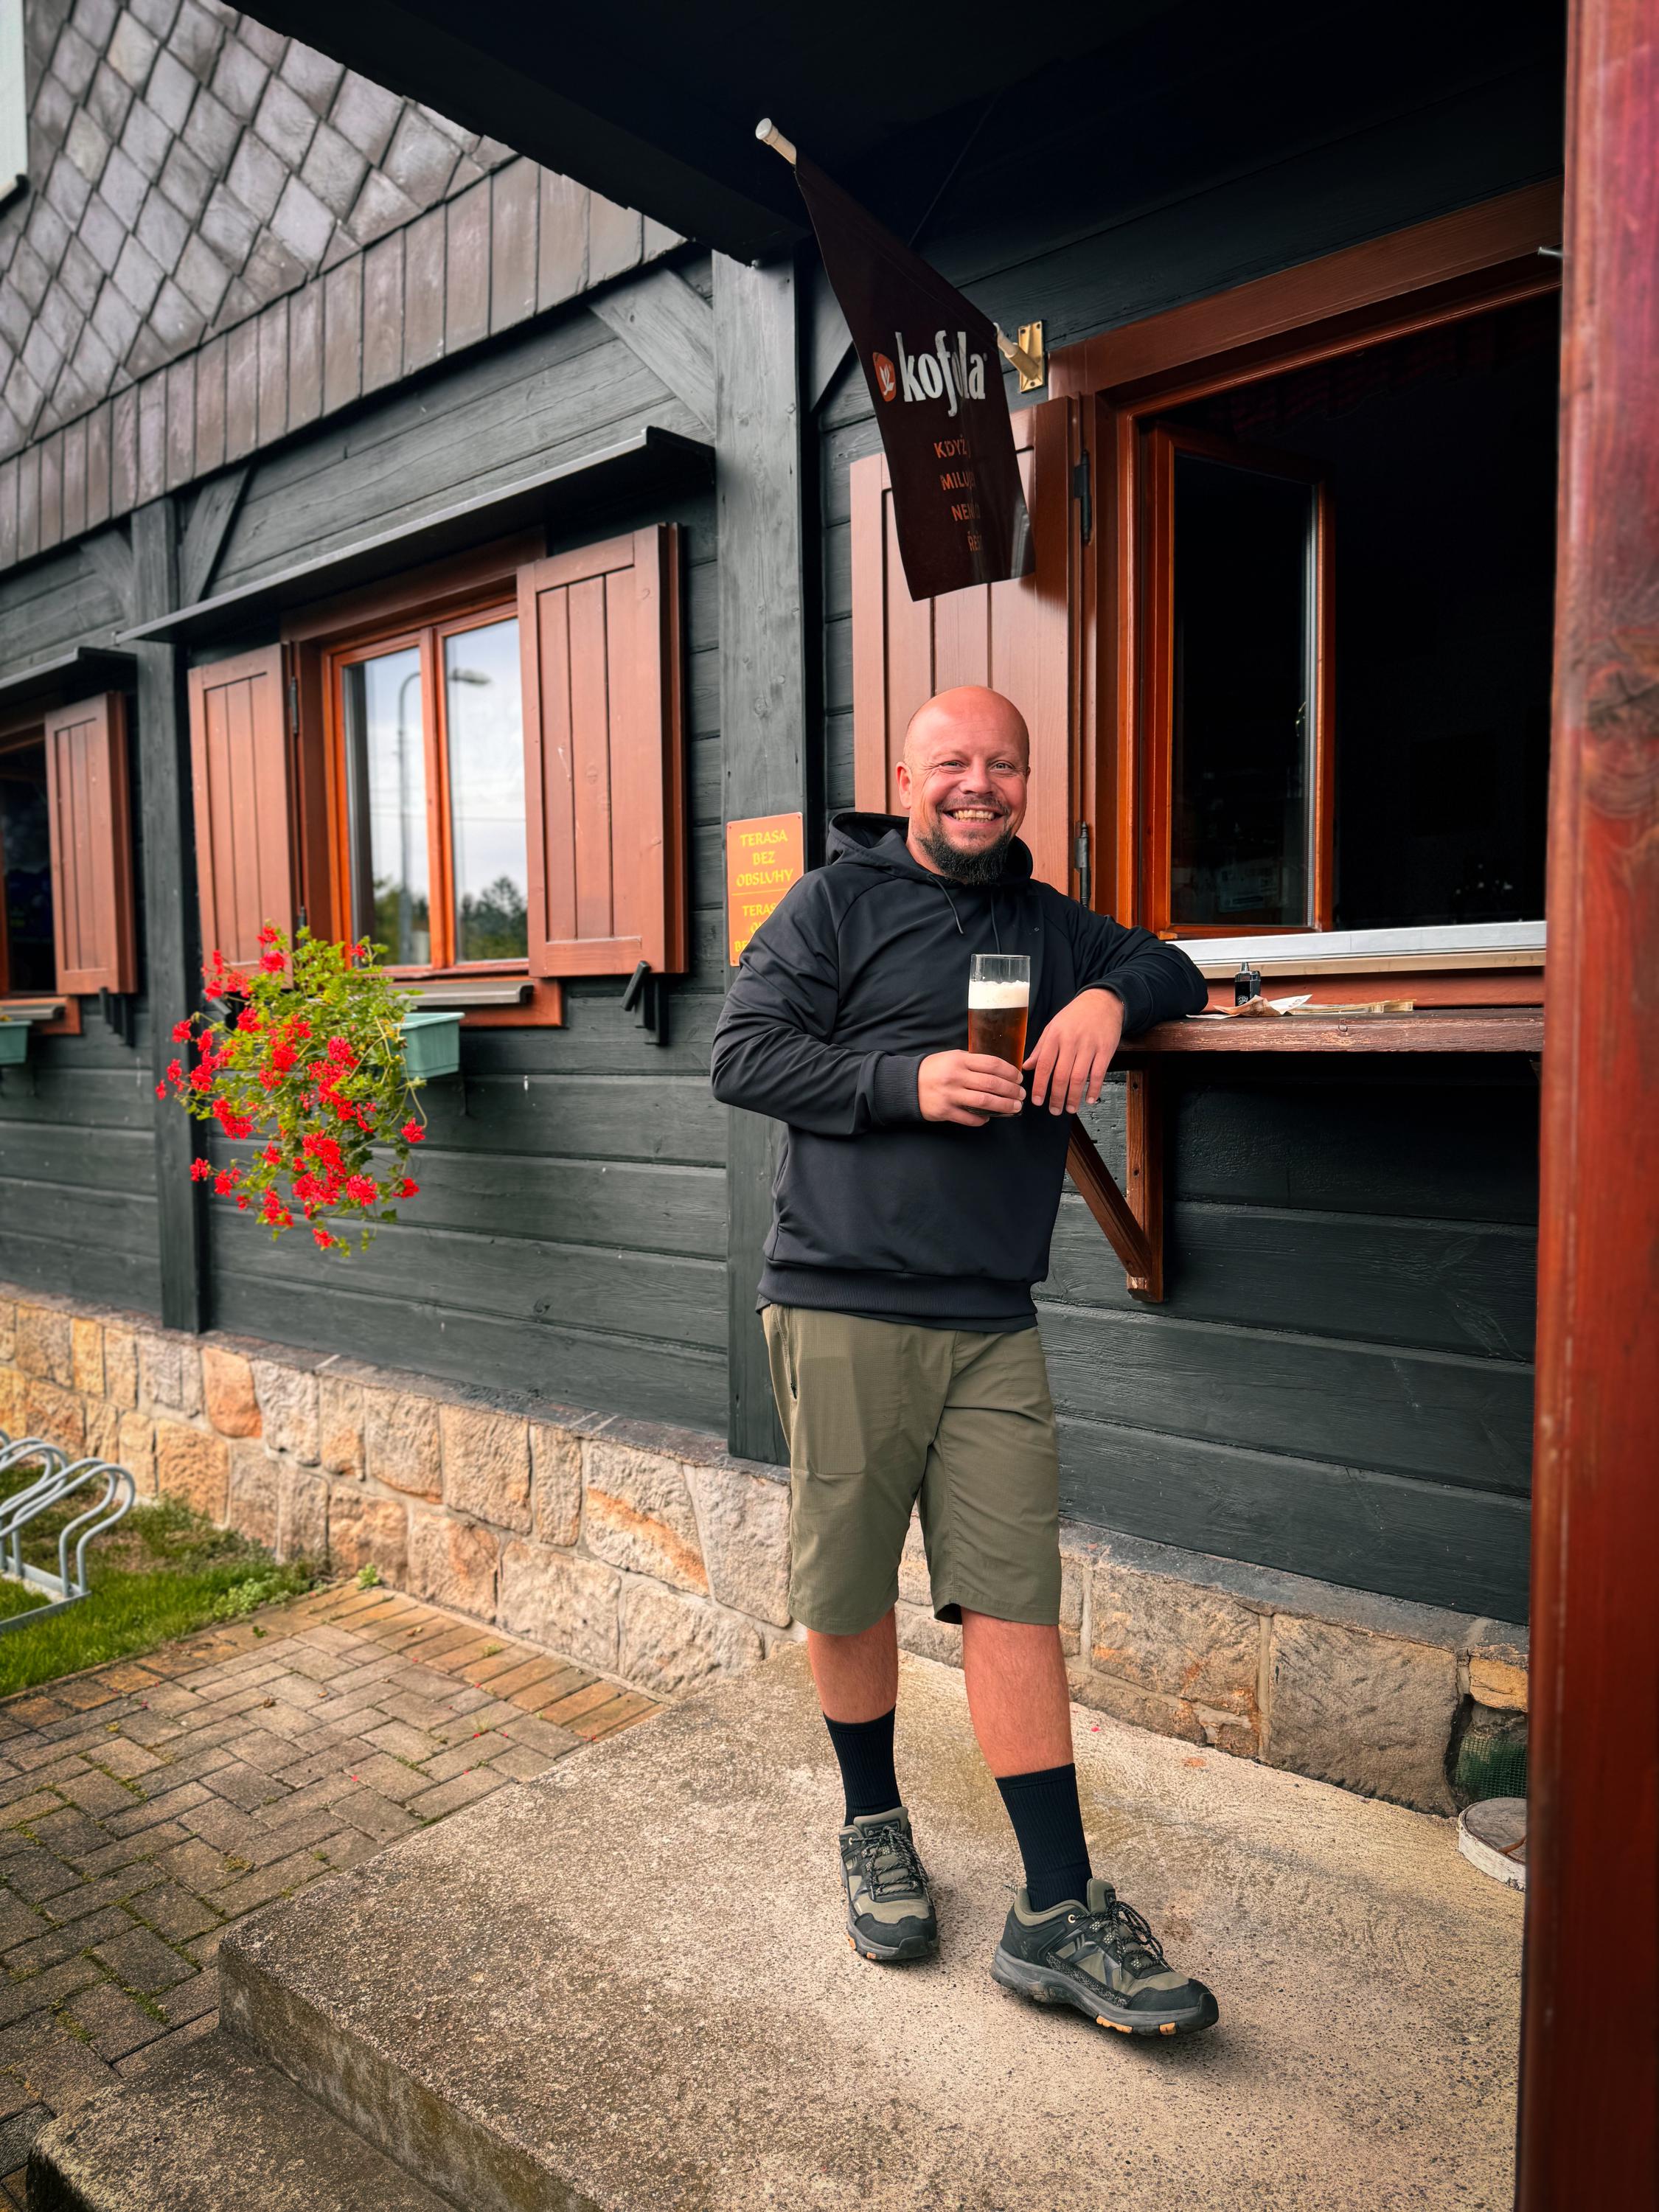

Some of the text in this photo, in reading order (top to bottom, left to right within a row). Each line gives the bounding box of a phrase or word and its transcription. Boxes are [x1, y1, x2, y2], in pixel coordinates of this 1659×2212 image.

[740, 830, 788, 846] TERASA
[752, 851, 775, 866] BEZ
[737, 869, 793, 886] OBSLUHY
